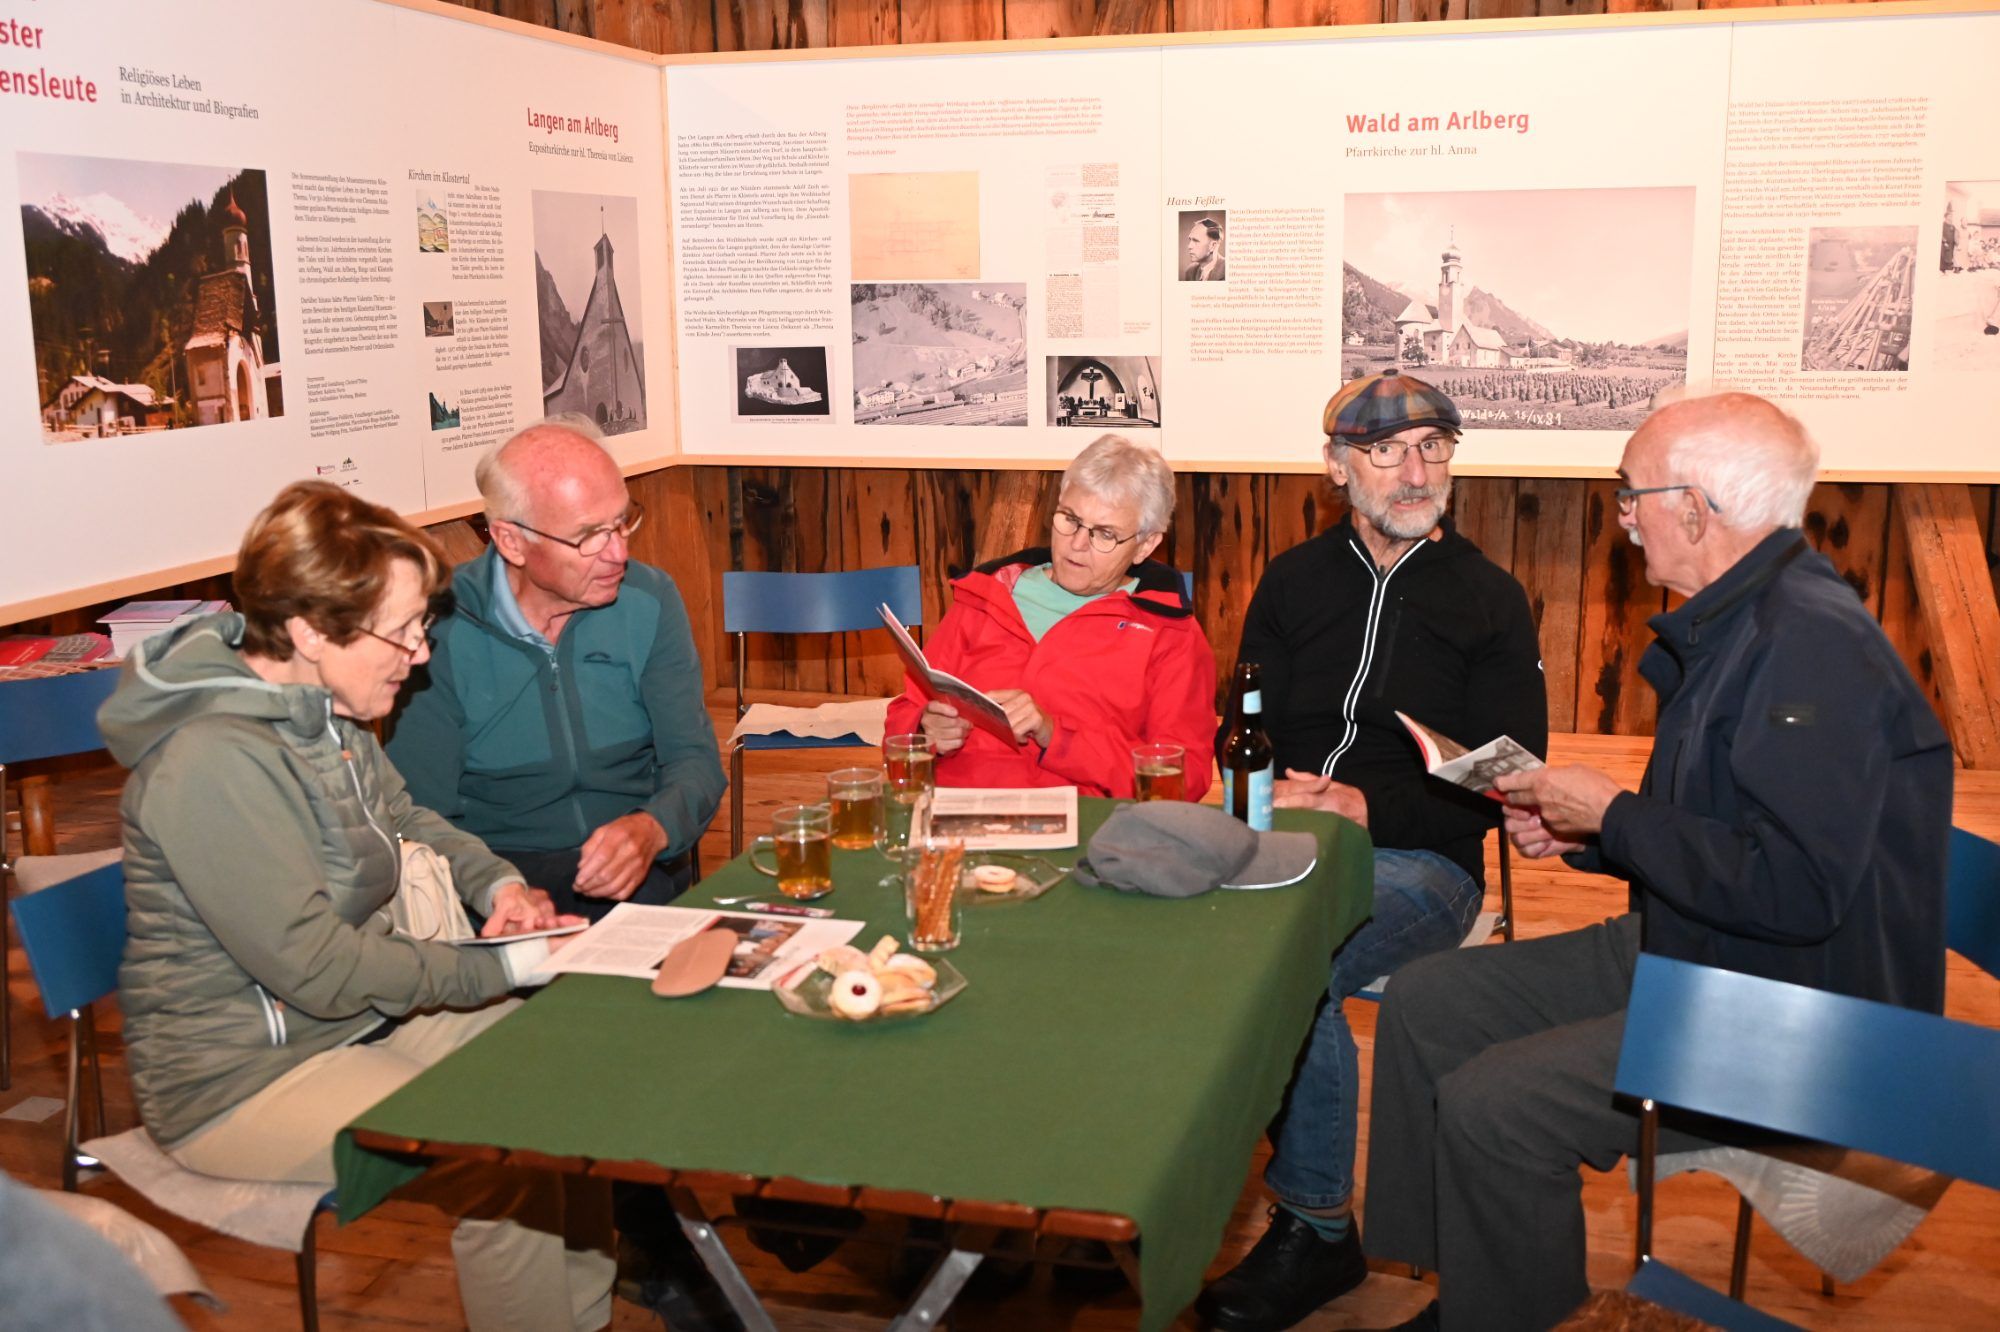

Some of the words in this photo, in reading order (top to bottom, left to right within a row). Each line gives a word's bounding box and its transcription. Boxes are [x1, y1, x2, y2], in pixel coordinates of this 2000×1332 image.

[0, 18, 43, 49] ster
[0, 68, 97, 102] ensleute
[119, 66, 170, 88] Religiöses
[172, 74, 202, 92] Leben
[121, 89, 132, 104] in
[134, 91, 190, 112] Architektur
[192, 99, 211, 114] und
[213, 100, 259, 120] Biografien
[528, 107, 564, 134] Langen
[567, 118, 582, 134] am
[584, 116, 618, 144] Arlberg
[1346, 112, 1400, 134] Wald
[1407, 116, 1440, 132] am
[1446, 110, 1529, 134] Arlberg
[587, 148, 608, 160] Theresia
[1346, 145, 1407, 158] Pfarrkirche
[1410, 146, 1428, 156] zur
[1431, 144, 1444, 155] hl.
[1448, 144, 1478, 156] Anna
[408, 169, 432, 181] Kirchen
[433, 170, 440, 182] im
[442, 172, 470, 184] Klostertal
[1167, 196, 1192, 206] Hans
[1194, 195, 1226, 208] Feßler
